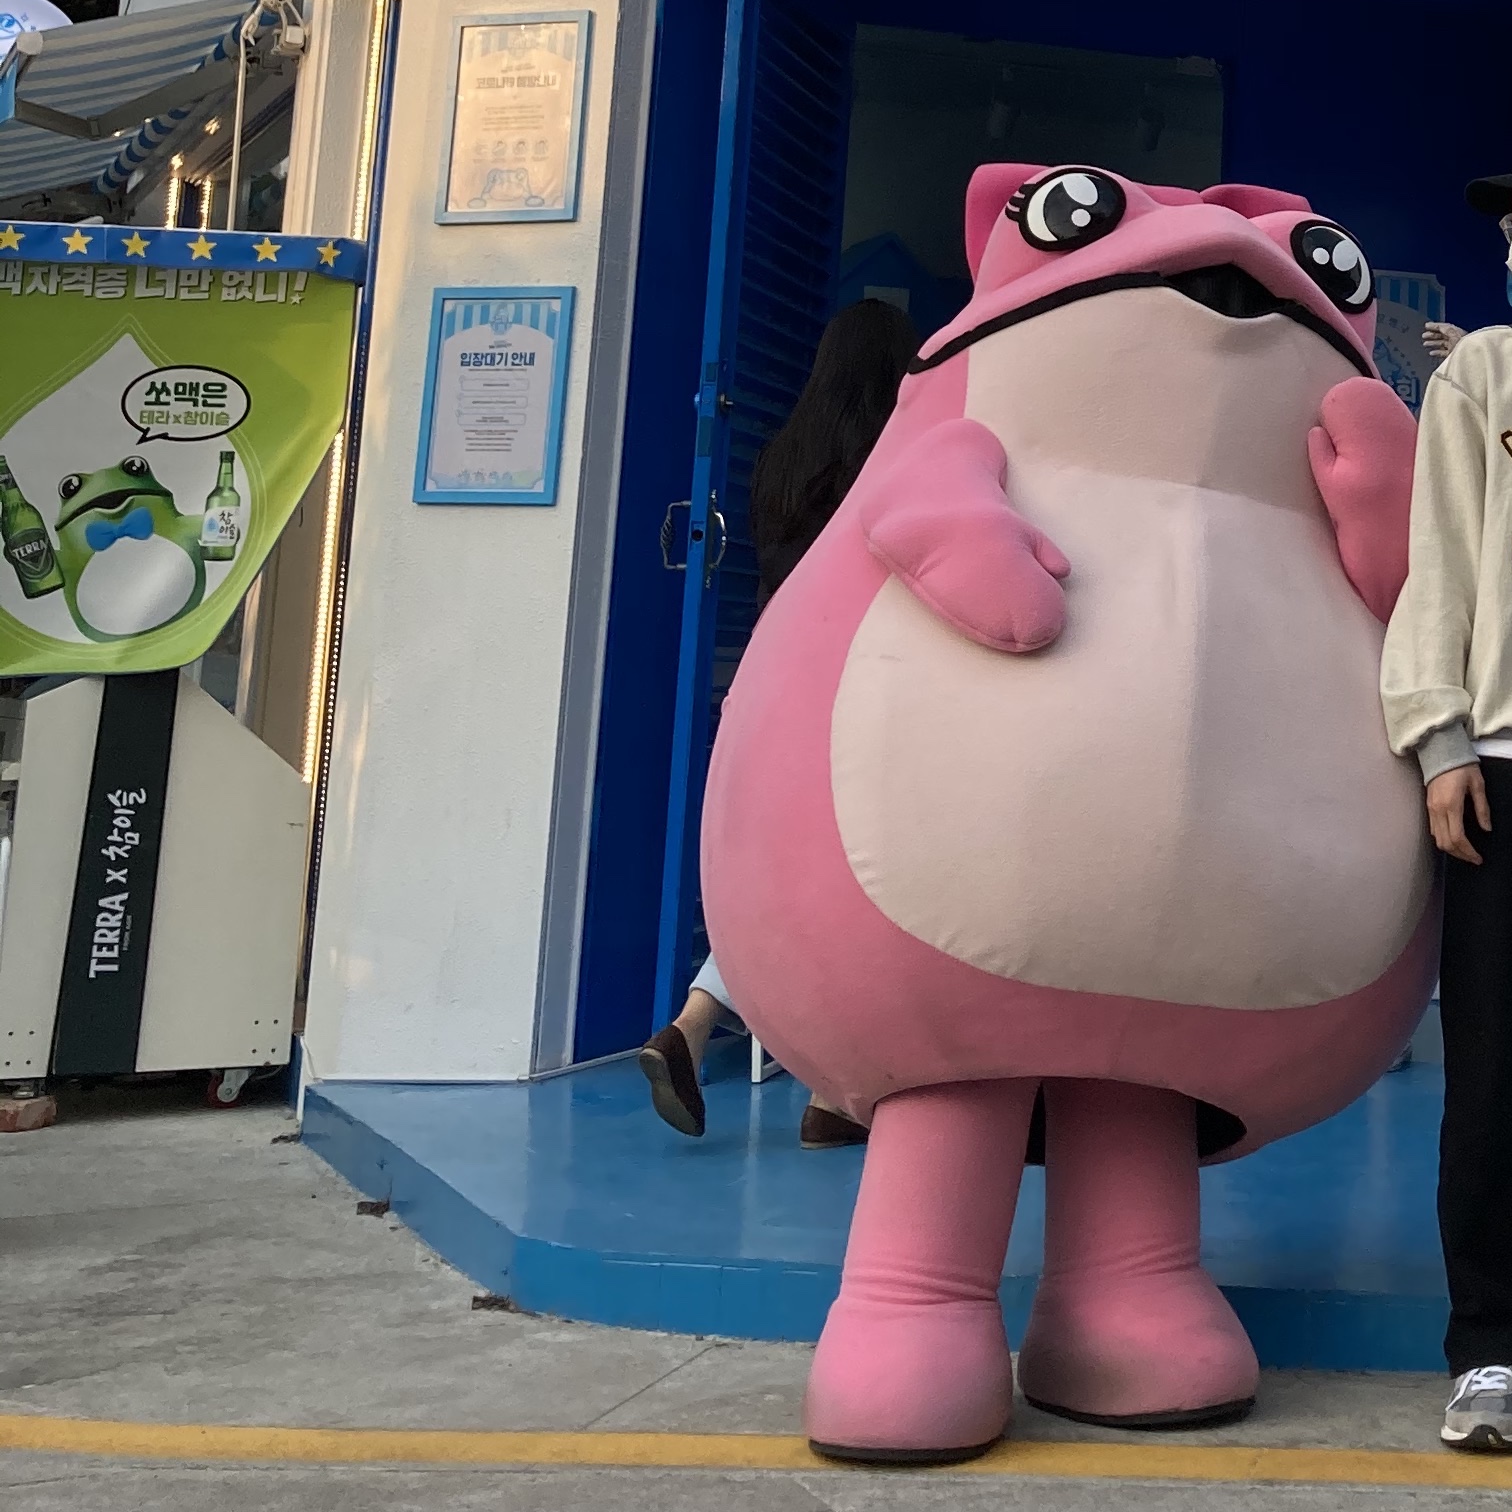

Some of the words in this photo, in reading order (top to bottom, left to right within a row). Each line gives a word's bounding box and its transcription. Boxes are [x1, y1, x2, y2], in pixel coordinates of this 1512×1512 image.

[134, 265, 215, 301] 너만
[220, 269, 310, 306] 없니!
[460, 352, 508, 367] 입장대기
[511, 352, 535, 367] 안내
[144, 381, 228, 408] 쏘맥은
[12, 538, 49, 561] TERRA
[100, 788, 147, 862] 참이슬
[89, 892, 129, 979] TERRA
